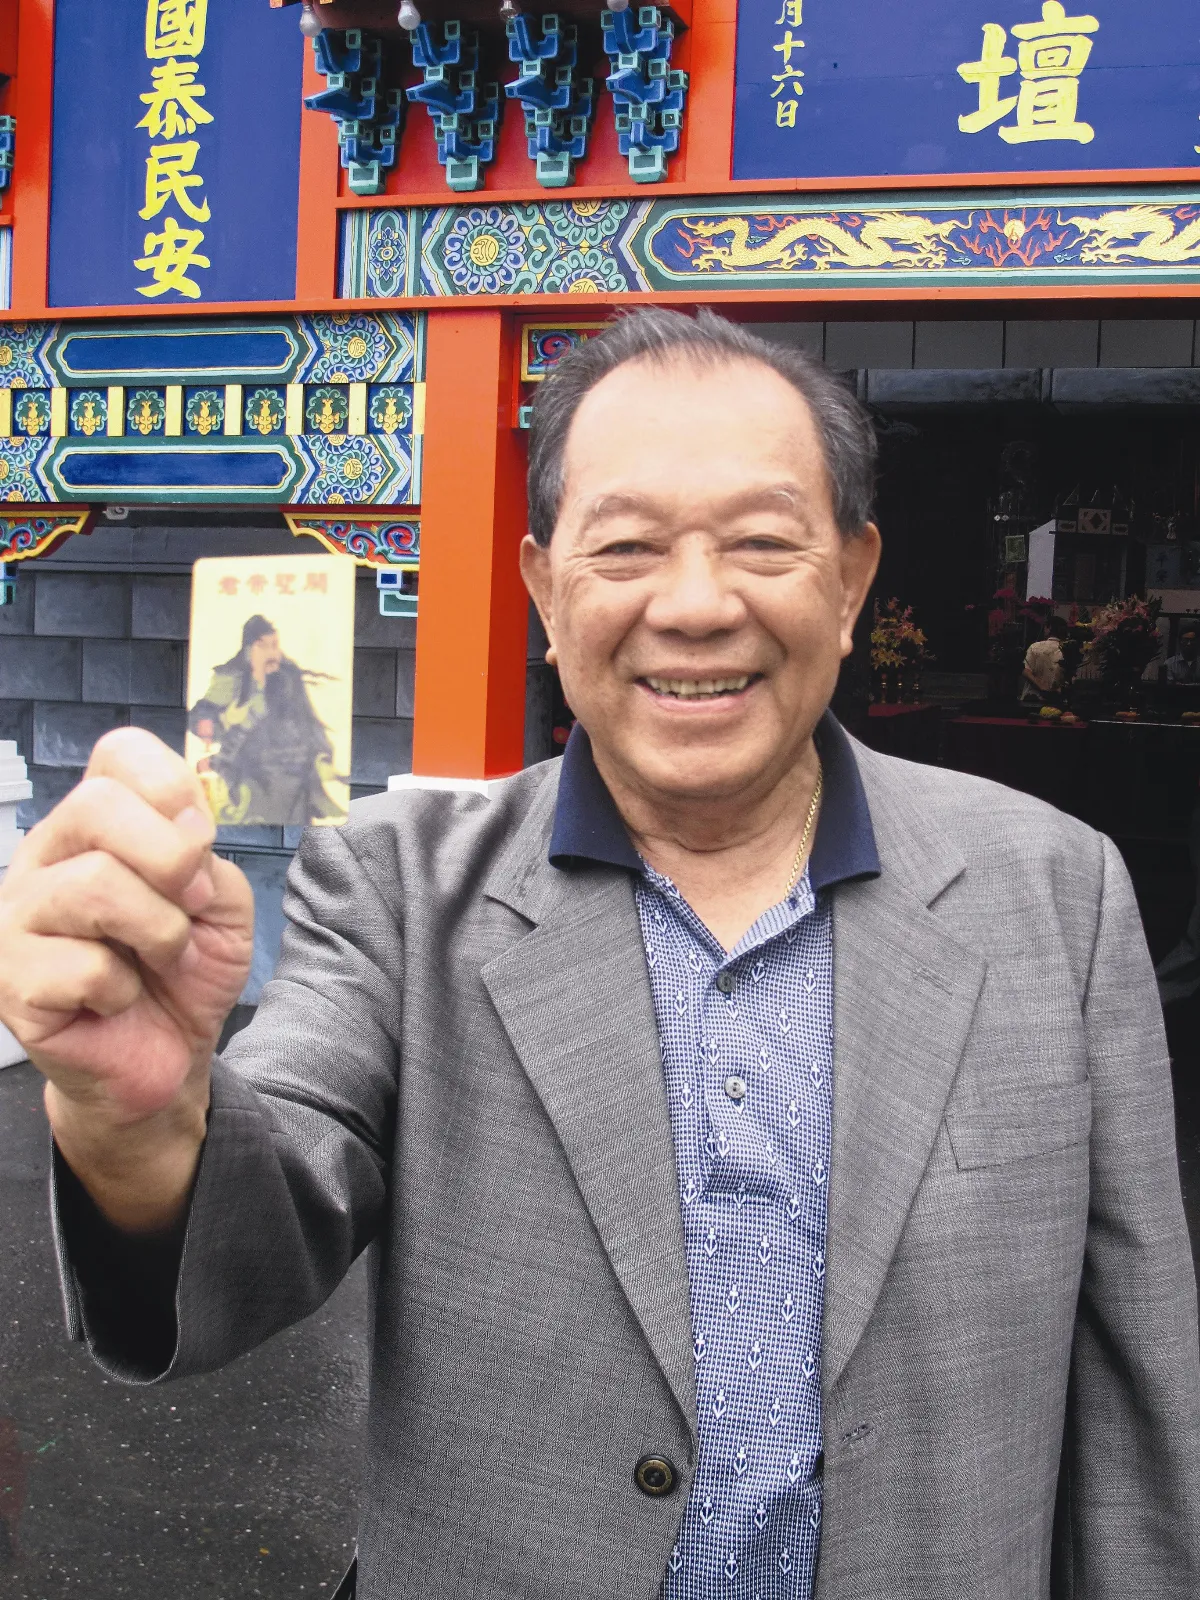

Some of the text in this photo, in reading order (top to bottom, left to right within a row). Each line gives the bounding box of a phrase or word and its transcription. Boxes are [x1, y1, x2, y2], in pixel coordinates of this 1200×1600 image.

[770, 0, 806, 128] 月十六日
[957, 0, 1100, 145] 壇
[134, 0, 214, 299] 國泰民安
